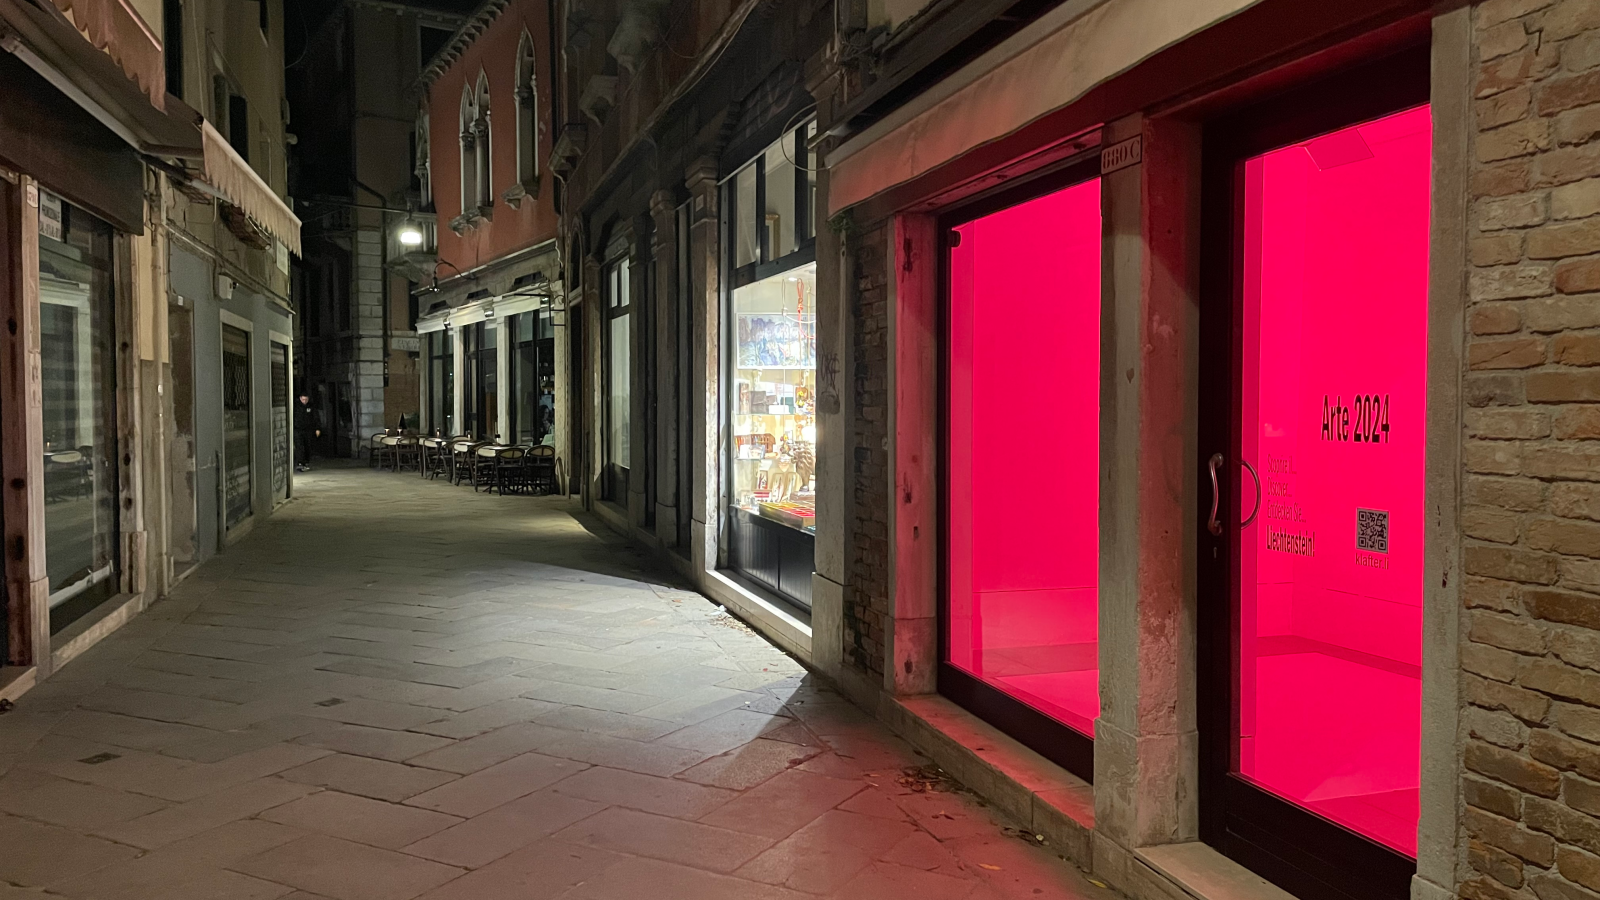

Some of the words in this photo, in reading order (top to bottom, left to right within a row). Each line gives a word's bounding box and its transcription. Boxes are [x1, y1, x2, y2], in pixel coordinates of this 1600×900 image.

[1103, 145, 1127, 169] 880
[1130, 140, 1140, 158] C
[1321, 395, 1350, 442] Arte
[1353, 394, 1390, 443] 2024
[1267, 453, 1288, 477] Scoprire
[1267, 499, 1293, 521] Entdecken
[1266, 525, 1315, 557] Liechtenstein!
[1355, 552, 1389, 569] klafter.li
